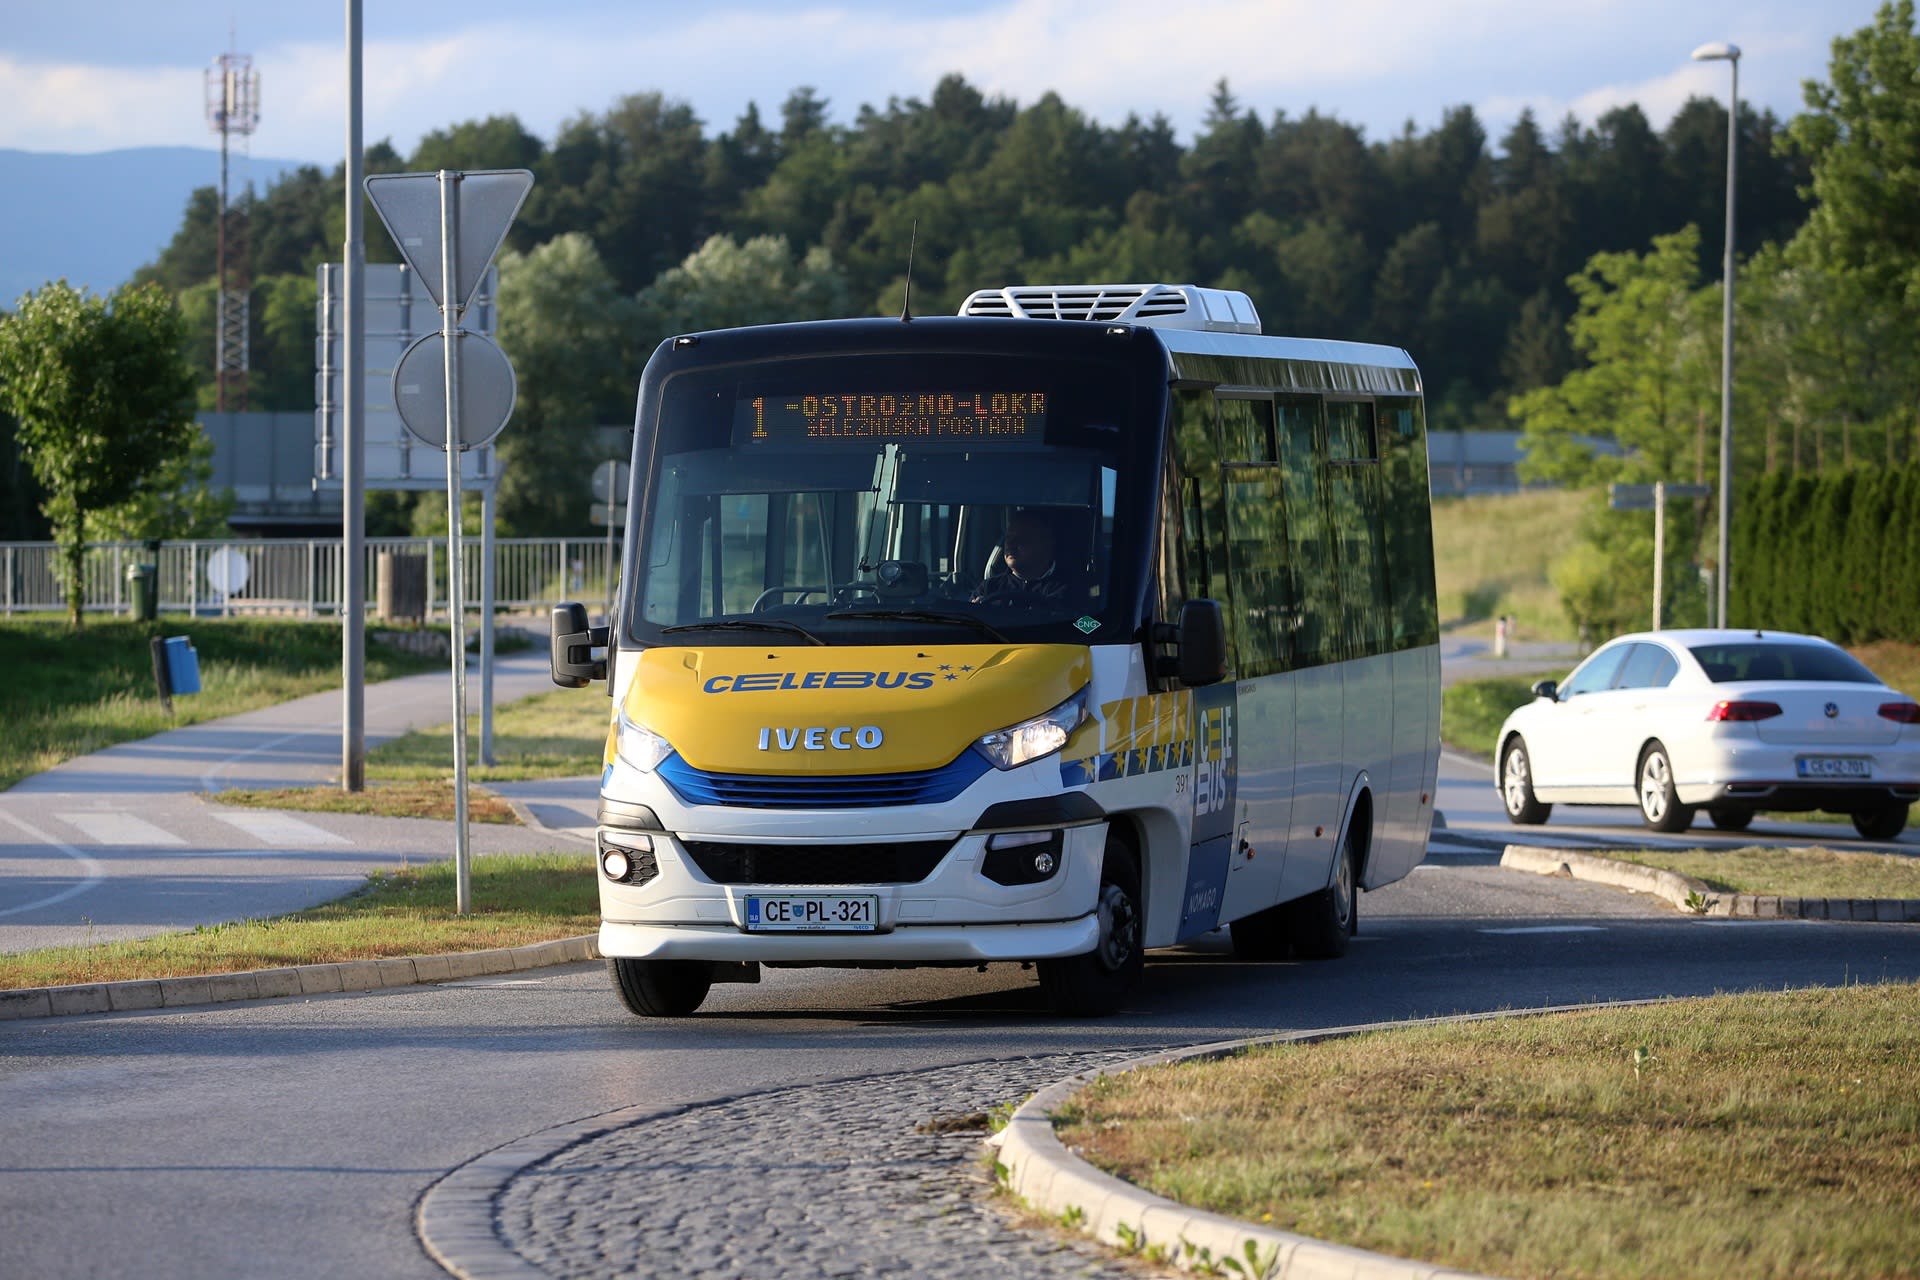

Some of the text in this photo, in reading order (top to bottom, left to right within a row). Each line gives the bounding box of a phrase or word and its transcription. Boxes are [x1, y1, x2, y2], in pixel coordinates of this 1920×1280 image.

[752, 396, 768, 437] 1
[938, 415, 1025, 435] POSTAJA
[1077, 620, 1097, 628] CNG
[703, 671, 936, 694] CELEBUS
[758, 725, 884, 751] IVECO
[1811, 759, 1825, 772] CE
[1175, 774, 1189, 793] 391
[765, 900, 870, 922] CE PL-321
